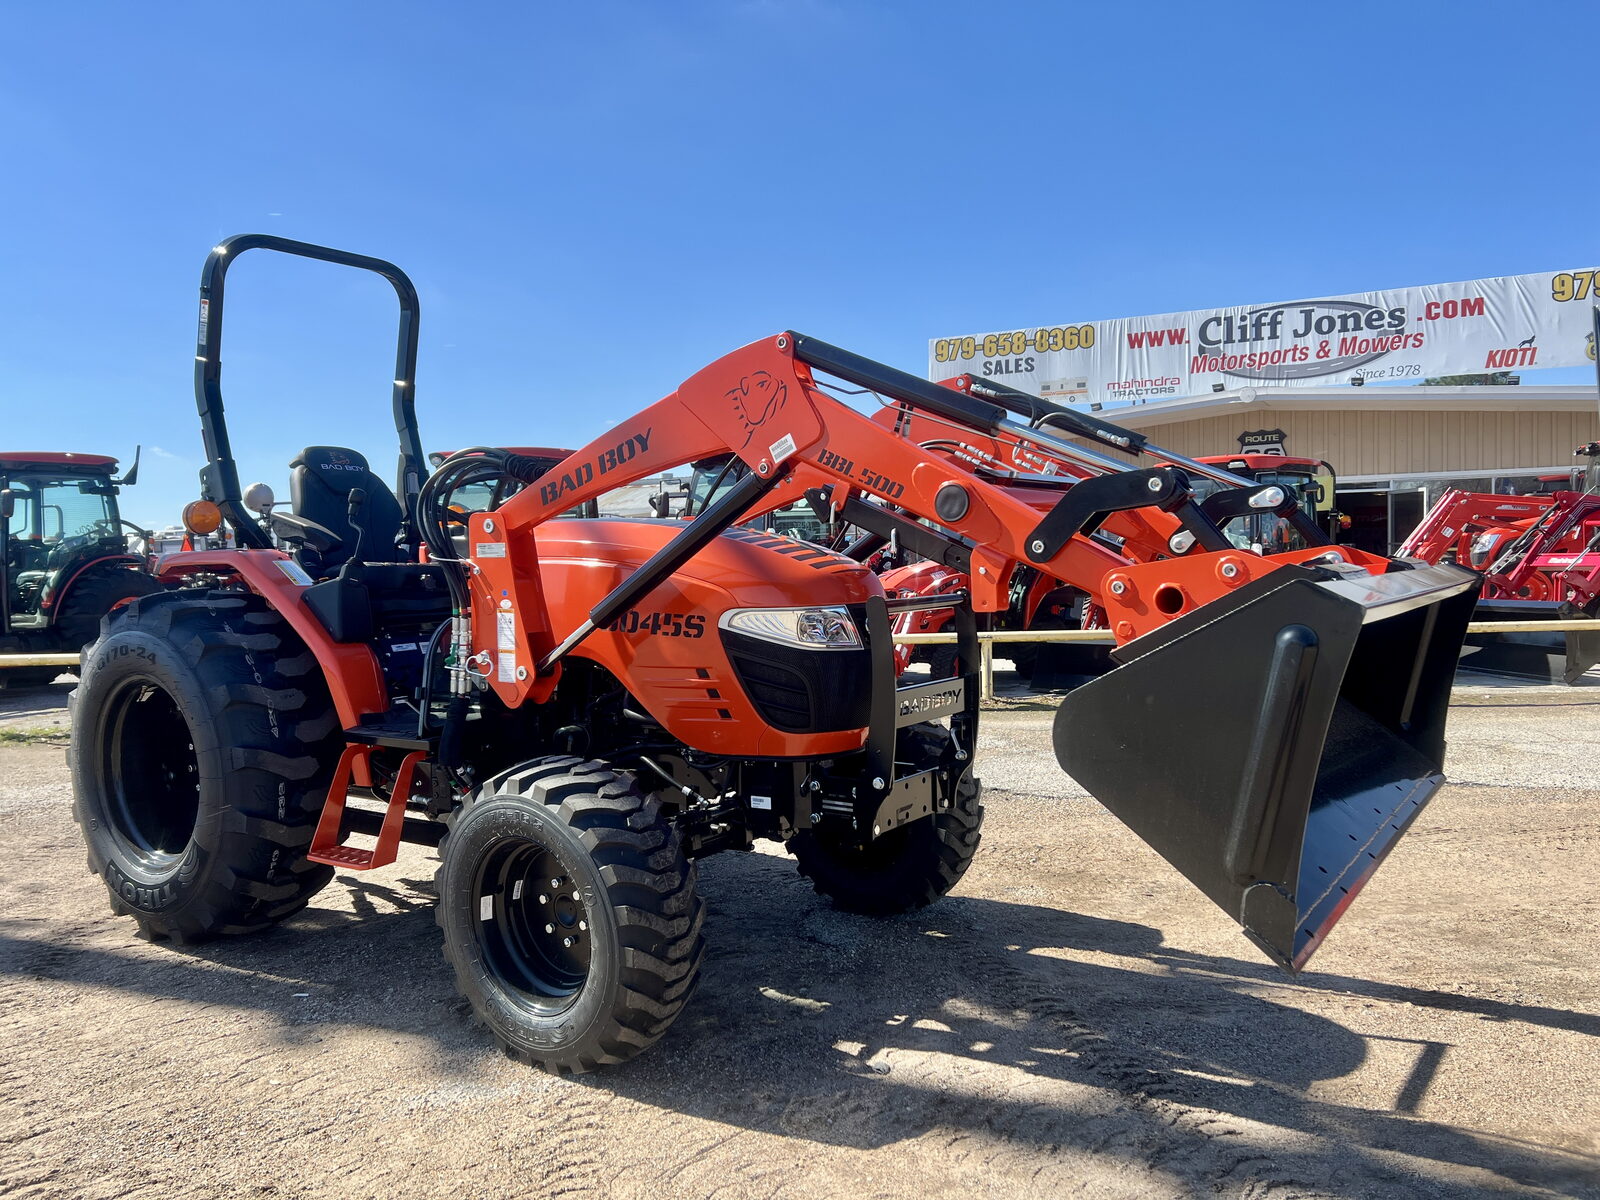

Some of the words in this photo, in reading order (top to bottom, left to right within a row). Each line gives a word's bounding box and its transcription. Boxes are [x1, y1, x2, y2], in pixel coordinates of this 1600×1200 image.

[1199, 310, 1284, 346] Cliff
[1293, 307, 1406, 338] Jones
[935, 325, 1095, 362] 979-658-8360
[1190, 344, 1309, 374] Motorsports
[1316, 340, 1331, 359] &
[1338, 332, 1424, 357] Mowers
[982, 357, 1035, 376] SALES
[1485, 347, 1537, 368] KIOTI
[1355, 364, 1385, 379] Since
[1389, 364, 1421, 377] 1978
[1107, 376, 1180, 390] mahindra
[1113, 386, 1175, 397] TRACTORS
[1245, 434, 1279, 443] ROUTE
[541, 462, 593, 506] BAD
[598, 427, 652, 476] BOY
[817, 448, 854, 478] BBL
[858, 468, 905, 499] 500
